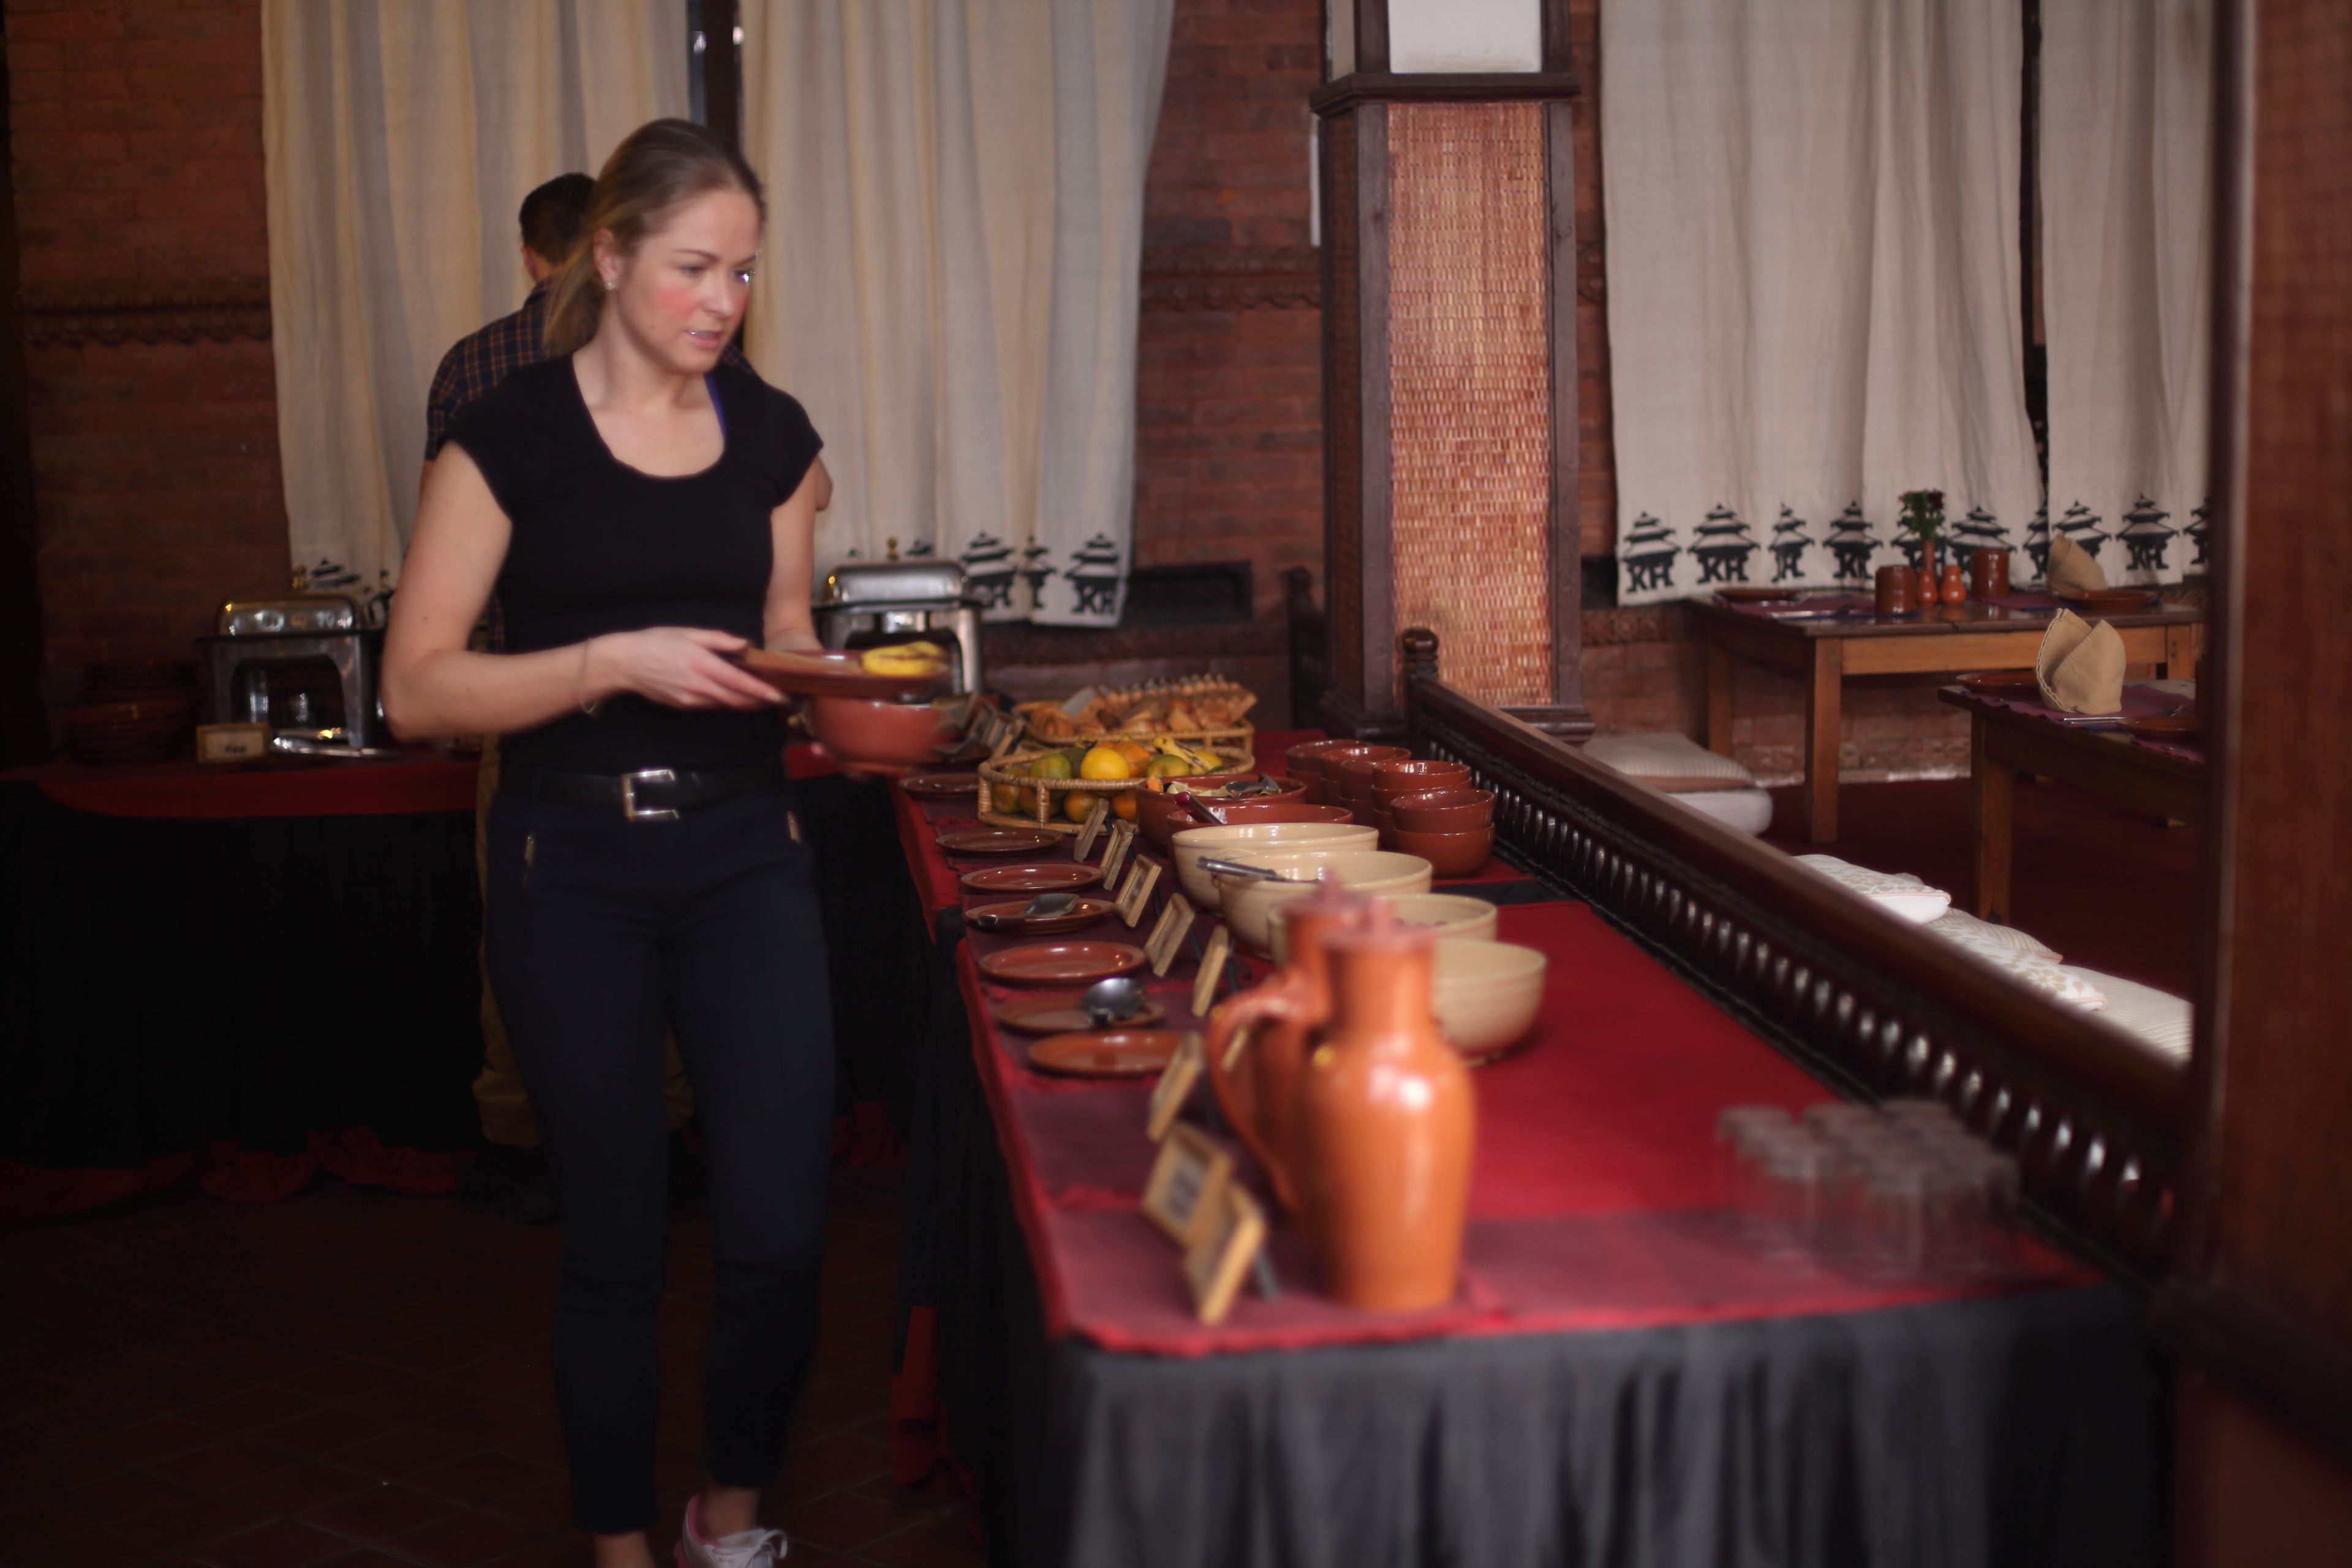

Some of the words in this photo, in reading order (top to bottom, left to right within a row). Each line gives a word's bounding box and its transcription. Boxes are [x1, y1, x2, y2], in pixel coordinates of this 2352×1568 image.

[1627, 560, 1675, 594] KH
[1697, 556, 1749, 584] KH
[1072, 586, 1115, 614] KH
